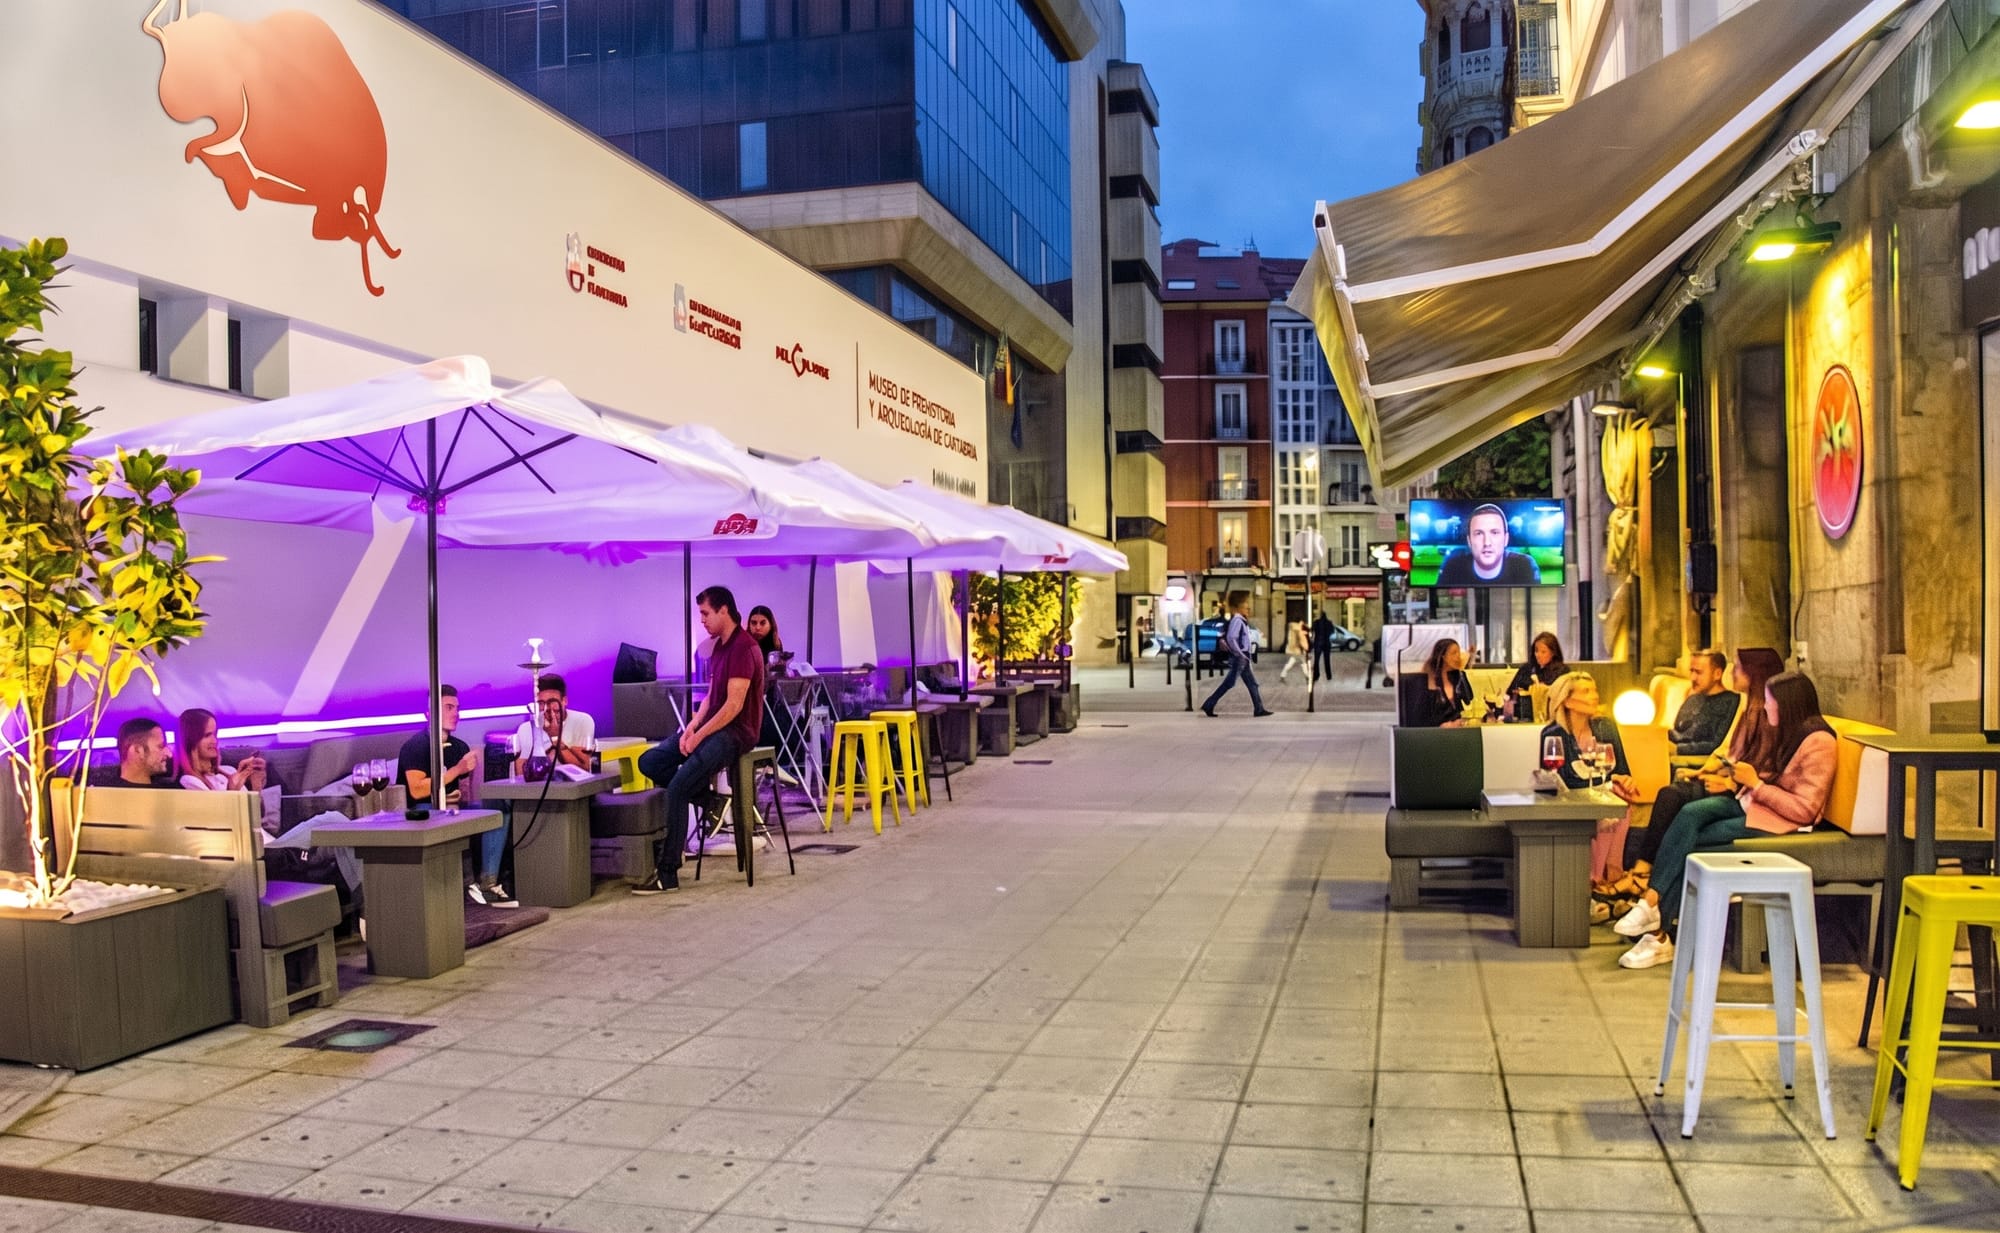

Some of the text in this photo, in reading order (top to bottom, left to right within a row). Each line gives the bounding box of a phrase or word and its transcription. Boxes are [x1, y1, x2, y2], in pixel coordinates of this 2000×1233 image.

[869, 370, 956, 429] MUSEO DE PREHISTORIA
[869, 397, 875, 418] Y
[933, 428, 943, 447] DE
